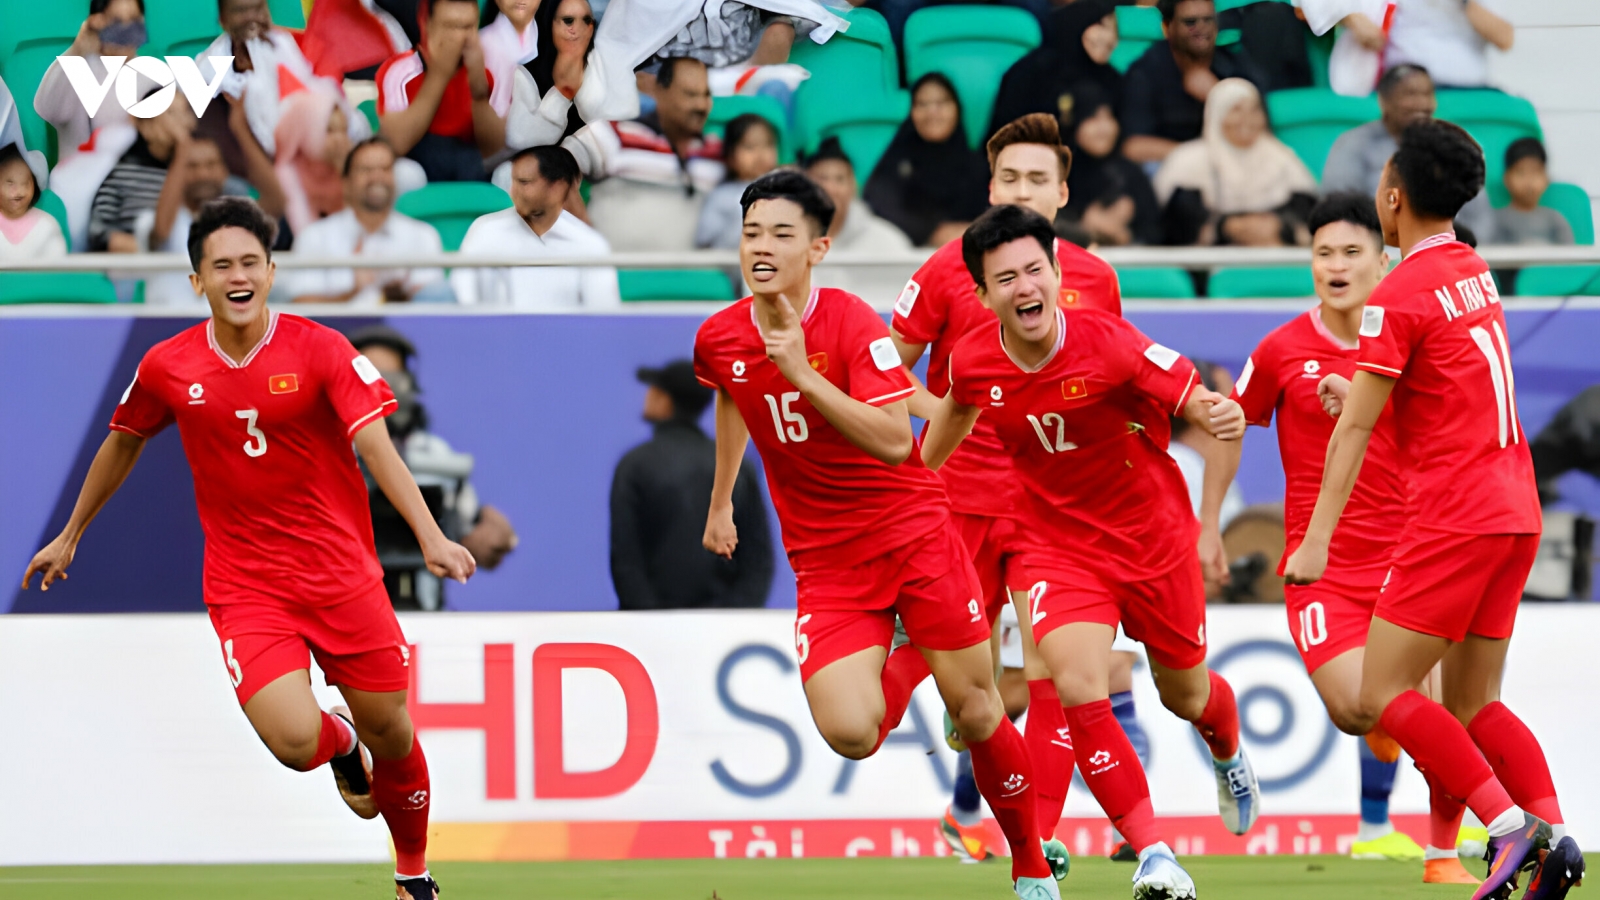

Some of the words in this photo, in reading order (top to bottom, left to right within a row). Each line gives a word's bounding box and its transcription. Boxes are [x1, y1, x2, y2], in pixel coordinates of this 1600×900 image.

[235, 408, 268, 458] 3
[763, 391, 809, 444] 15
[1026, 412, 1079, 454] 12
[1299, 601, 1329, 653] 10
[406, 642, 660, 800] HD
